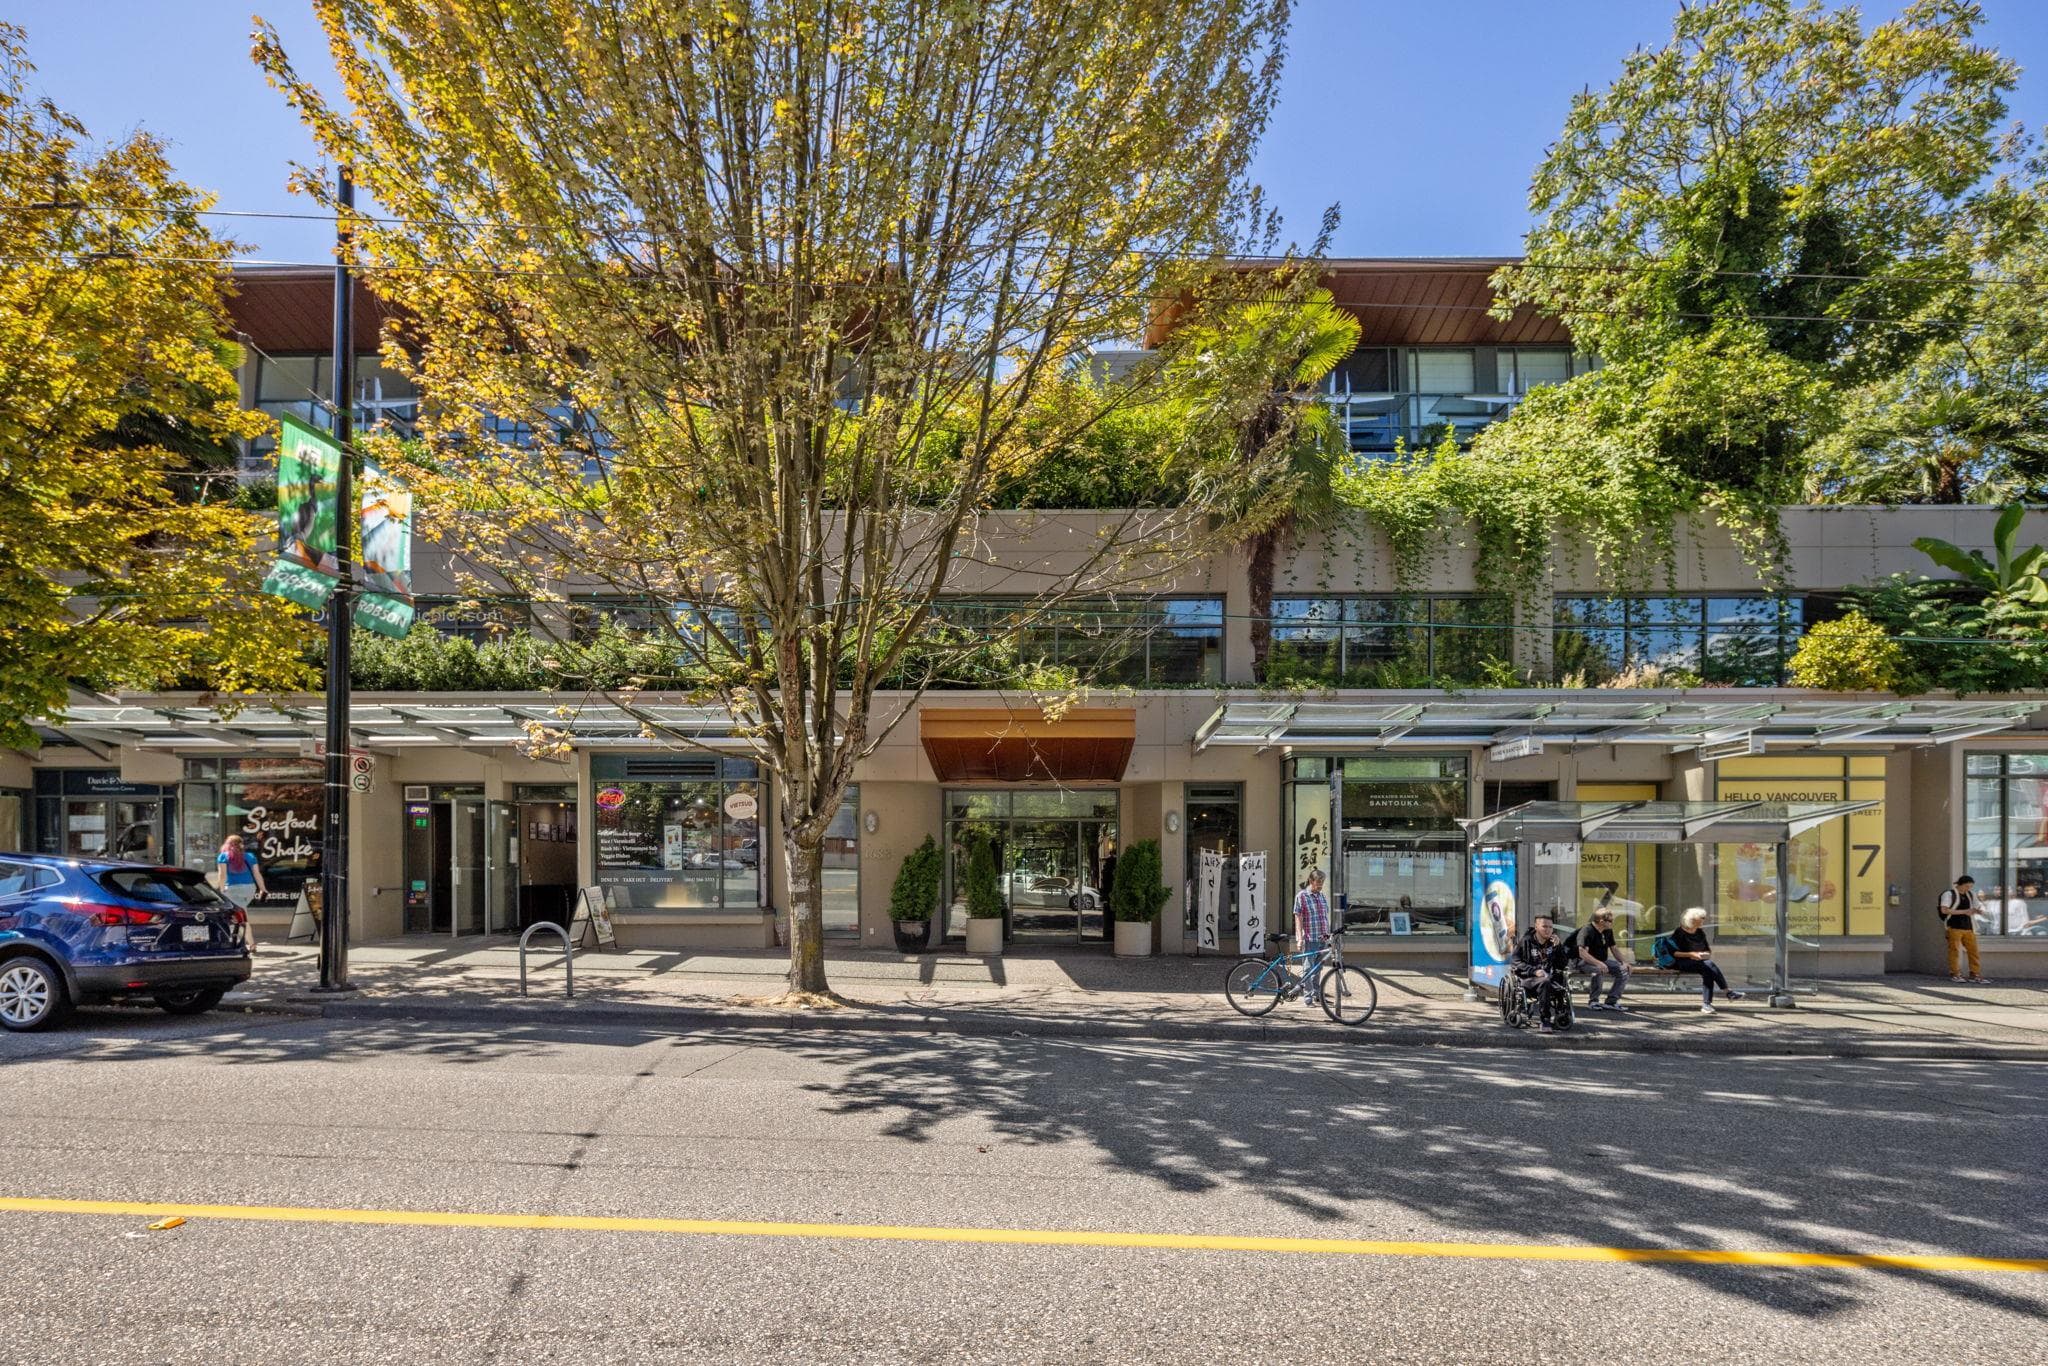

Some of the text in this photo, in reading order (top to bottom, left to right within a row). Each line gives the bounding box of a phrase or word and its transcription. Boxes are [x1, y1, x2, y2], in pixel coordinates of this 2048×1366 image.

[357, 600, 407, 628] ROBSON
[1724, 792, 1838, 801] HELLO VANCOUVER
[243, 806, 317, 839] Seafood
[1852, 808, 1882, 816] SWEET7
[261, 835, 313, 862] Shake
[1581, 854, 1621, 862] SWEET7
[1852, 844, 1881, 878] 7
